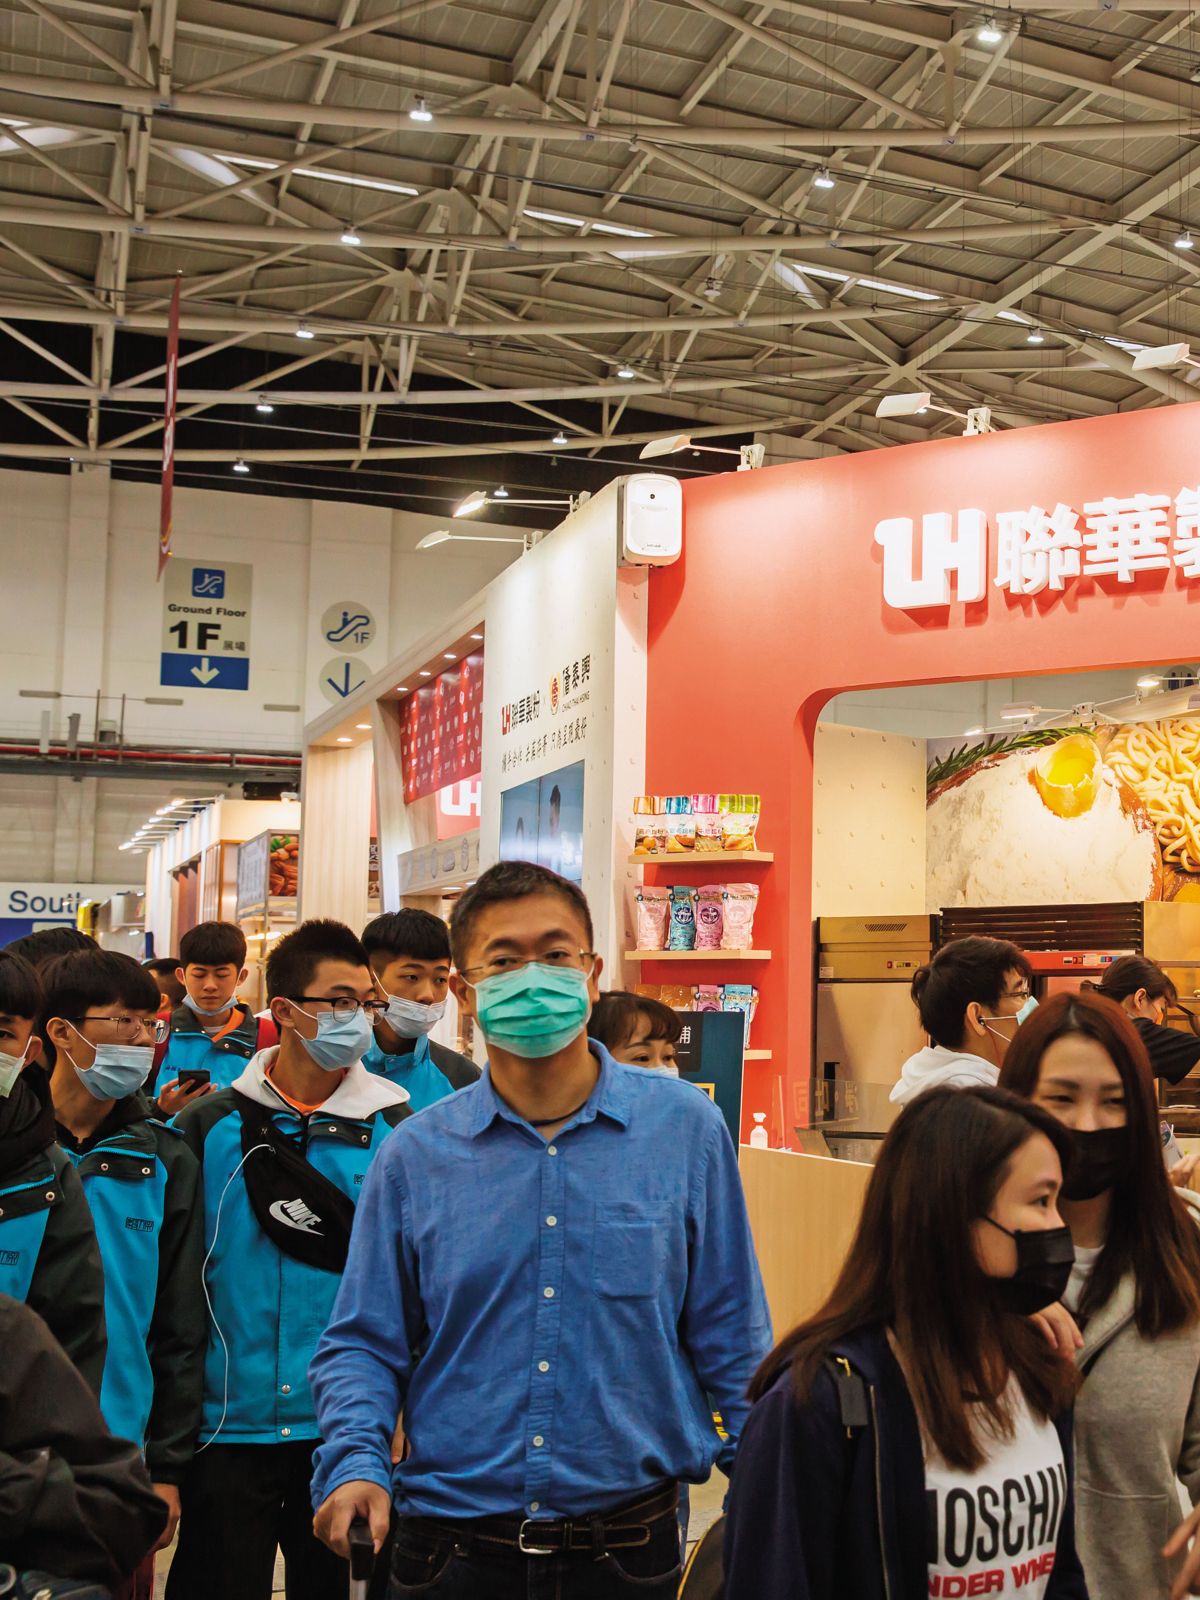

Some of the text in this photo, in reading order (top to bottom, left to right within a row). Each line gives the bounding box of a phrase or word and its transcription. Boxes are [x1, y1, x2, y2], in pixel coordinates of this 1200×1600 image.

[168, 603, 247, 618] Ground Floor
[169, 620, 222, 650] 1F
[353, 632, 370, 644] 1F
[282, 1198, 322, 1229] NIKE
[926, 1463, 1067, 1568] OSCHI
